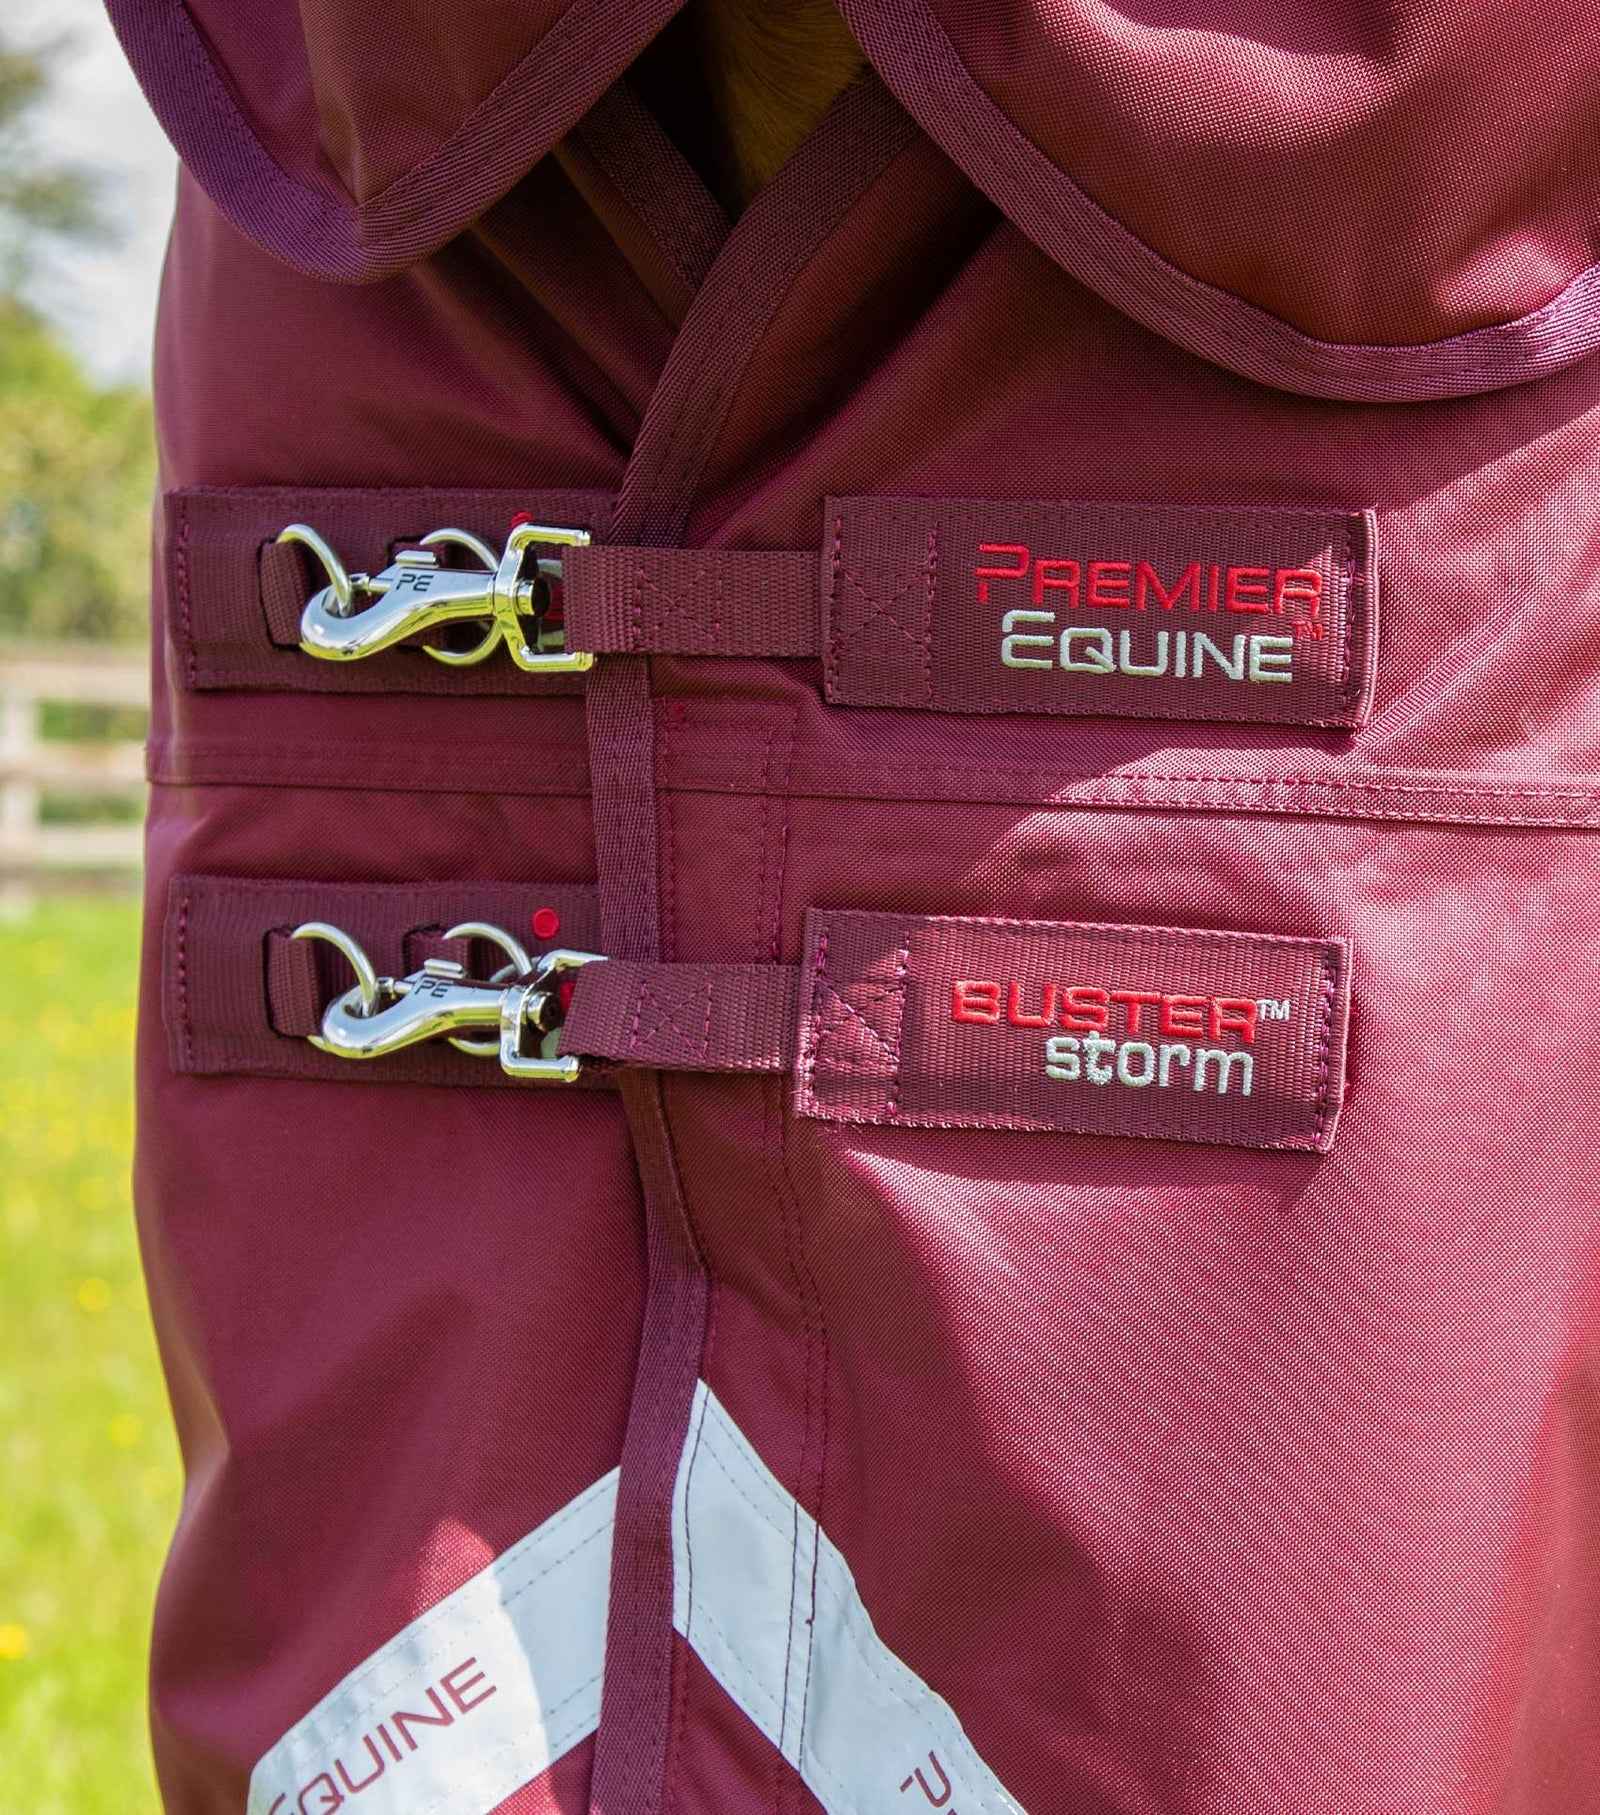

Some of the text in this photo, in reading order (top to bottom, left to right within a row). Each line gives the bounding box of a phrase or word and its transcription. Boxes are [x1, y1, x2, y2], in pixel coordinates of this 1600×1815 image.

[395, 573, 434, 592] PE
[975, 543, 1322, 617] PREMIER
[414, 980, 451, 998] PE
[1045, 1030, 1254, 1096] storm
